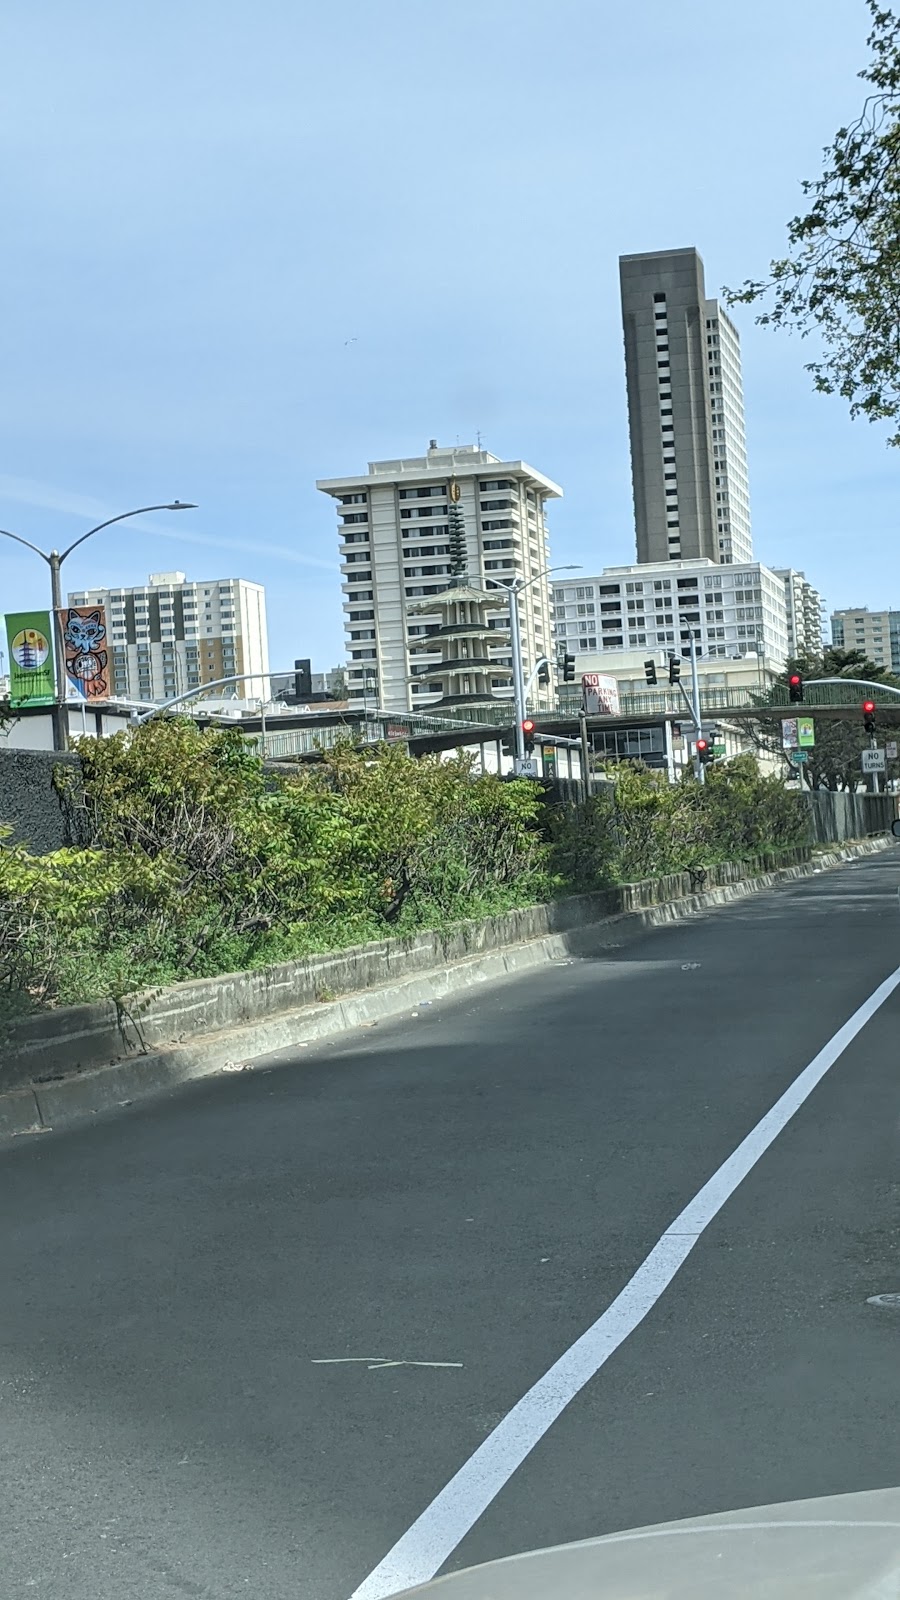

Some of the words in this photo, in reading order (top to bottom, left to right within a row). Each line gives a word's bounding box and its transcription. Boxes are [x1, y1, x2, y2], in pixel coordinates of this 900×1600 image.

[584, 675, 598, 686] NO
[587, 687, 617, 698] PARKING
[597, 696, 612, 704] ANY
[597, 703, 614, 713] TIME
[867, 752, 879, 760] NO
[521, 762, 532, 770] NO
[864, 761, 885, 770] TURNS
